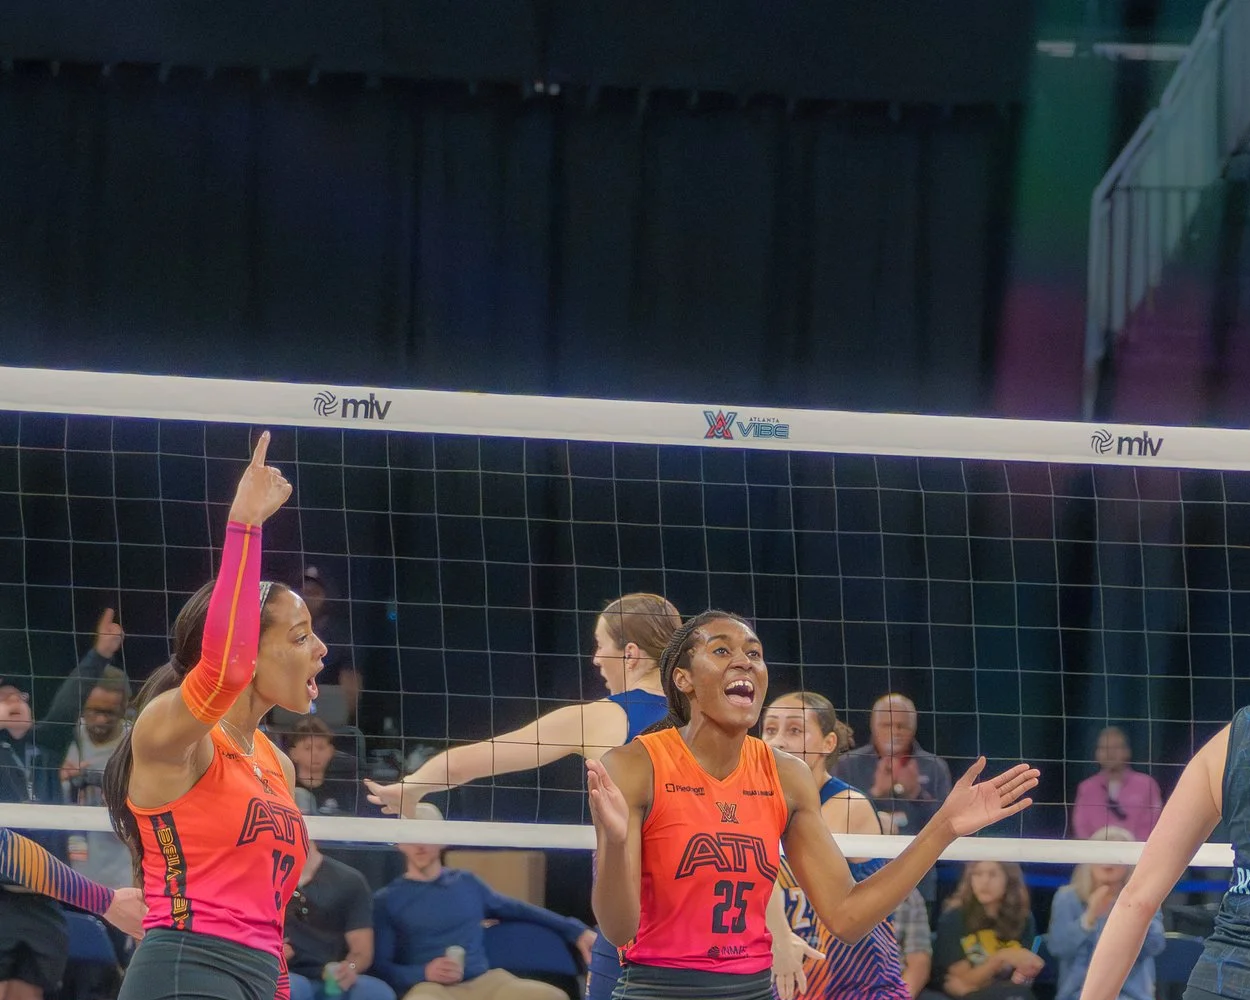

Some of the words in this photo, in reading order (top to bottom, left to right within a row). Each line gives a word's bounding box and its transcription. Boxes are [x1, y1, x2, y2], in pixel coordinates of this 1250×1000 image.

[341, 393, 392, 420] mlv
[737, 421, 789, 439] VIBE
[1117, 431, 1164, 457] mlv
[156, 827, 182, 881] VIBE
[674, 832, 779, 884] ATL
[711, 879, 755, 934] 25
